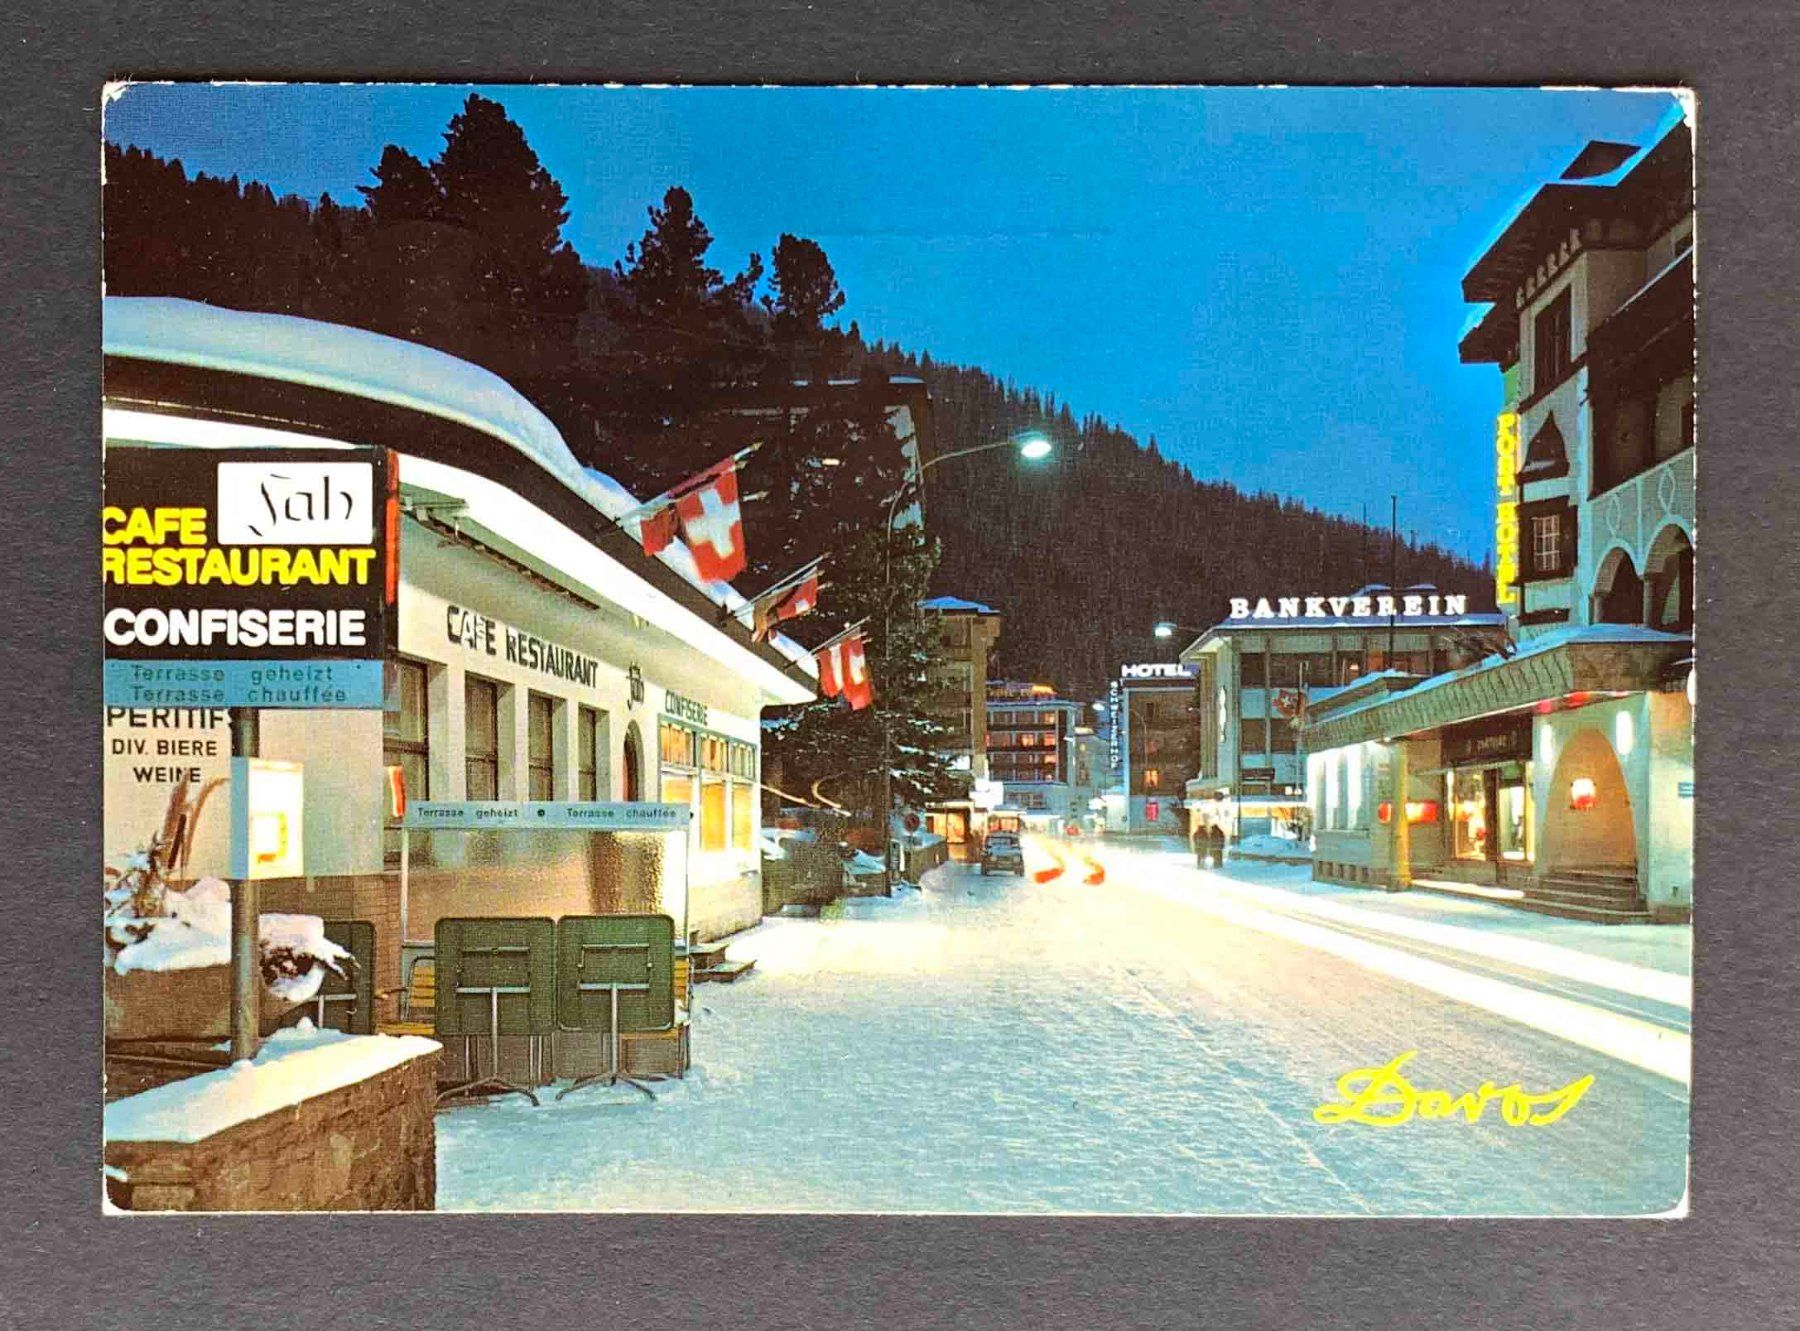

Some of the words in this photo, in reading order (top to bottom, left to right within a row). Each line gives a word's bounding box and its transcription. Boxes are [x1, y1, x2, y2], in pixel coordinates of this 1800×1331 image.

[102, 507, 207, 545] CAFE
[102, 548, 376, 586] RESTAURANT
[1229, 595, 1467, 619] BANKVEREIN
[103, 608, 366, 646] CONFISERIE
[447, 605, 496, 656] CAFE
[506, 625, 599, 688] RESTAURANT
[131, 665, 225, 682] Terrasse
[251, 664, 334, 684] geheizt
[1121, 663, 1192, 678] HOTEL
[131, 686, 225, 702] Terrasse
[665, 689, 708, 726] CONFISERIE
[112, 739, 149, 755] DIV.
[157, 740, 217, 756] BIERE
[417, 806, 464, 818] Terrasse
[476, 807, 518, 820] geheizt
[567, 807, 614, 819] Terrasse
